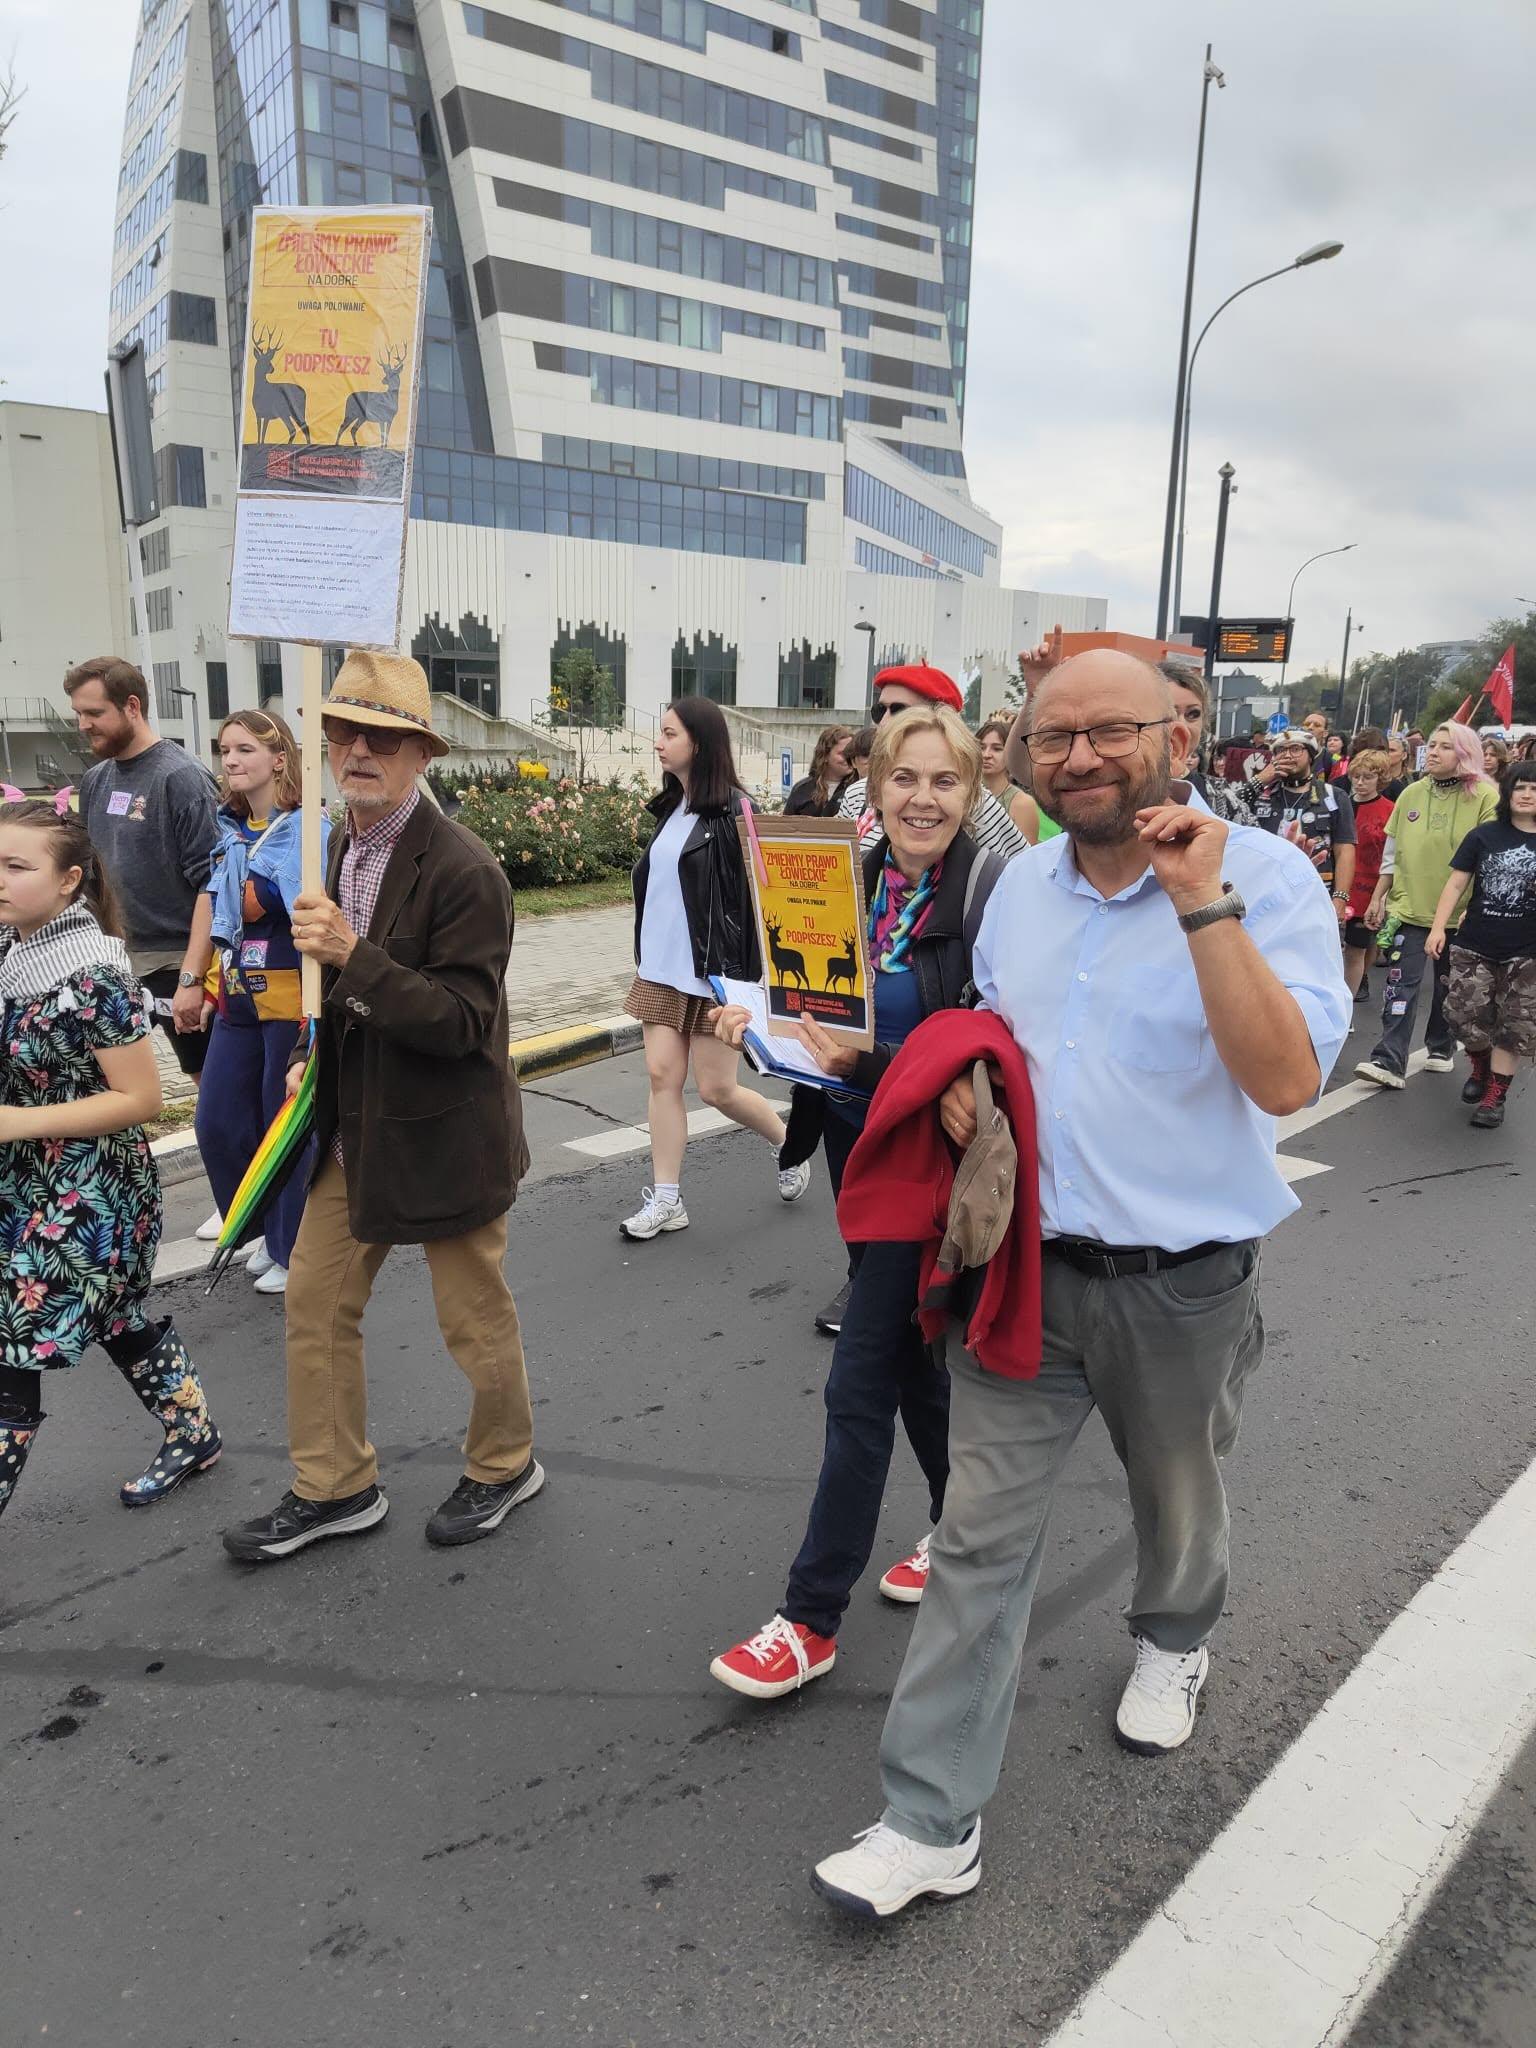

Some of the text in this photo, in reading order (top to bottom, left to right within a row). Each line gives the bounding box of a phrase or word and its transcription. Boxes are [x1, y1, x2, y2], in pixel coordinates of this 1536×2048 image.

[344, 233, 400, 254] PRAWO
[295, 253, 376, 275] ŁOWIECKIE
[307, 274, 359, 286] NA DOBRE
[297, 300, 366, 312] UWAGA POLOWANIE
[319, 328, 339, 349] TU
[284, 352, 371, 375] PODPISZESZ
[805, 854, 838, 869] PRAWO
[780, 867, 828, 882] ŁOWIECKIE
[800, 881, 820, 890] DOBRE
[803, 916, 815, 930] TU
[786, 929, 837, 947] PODPISZESZ
